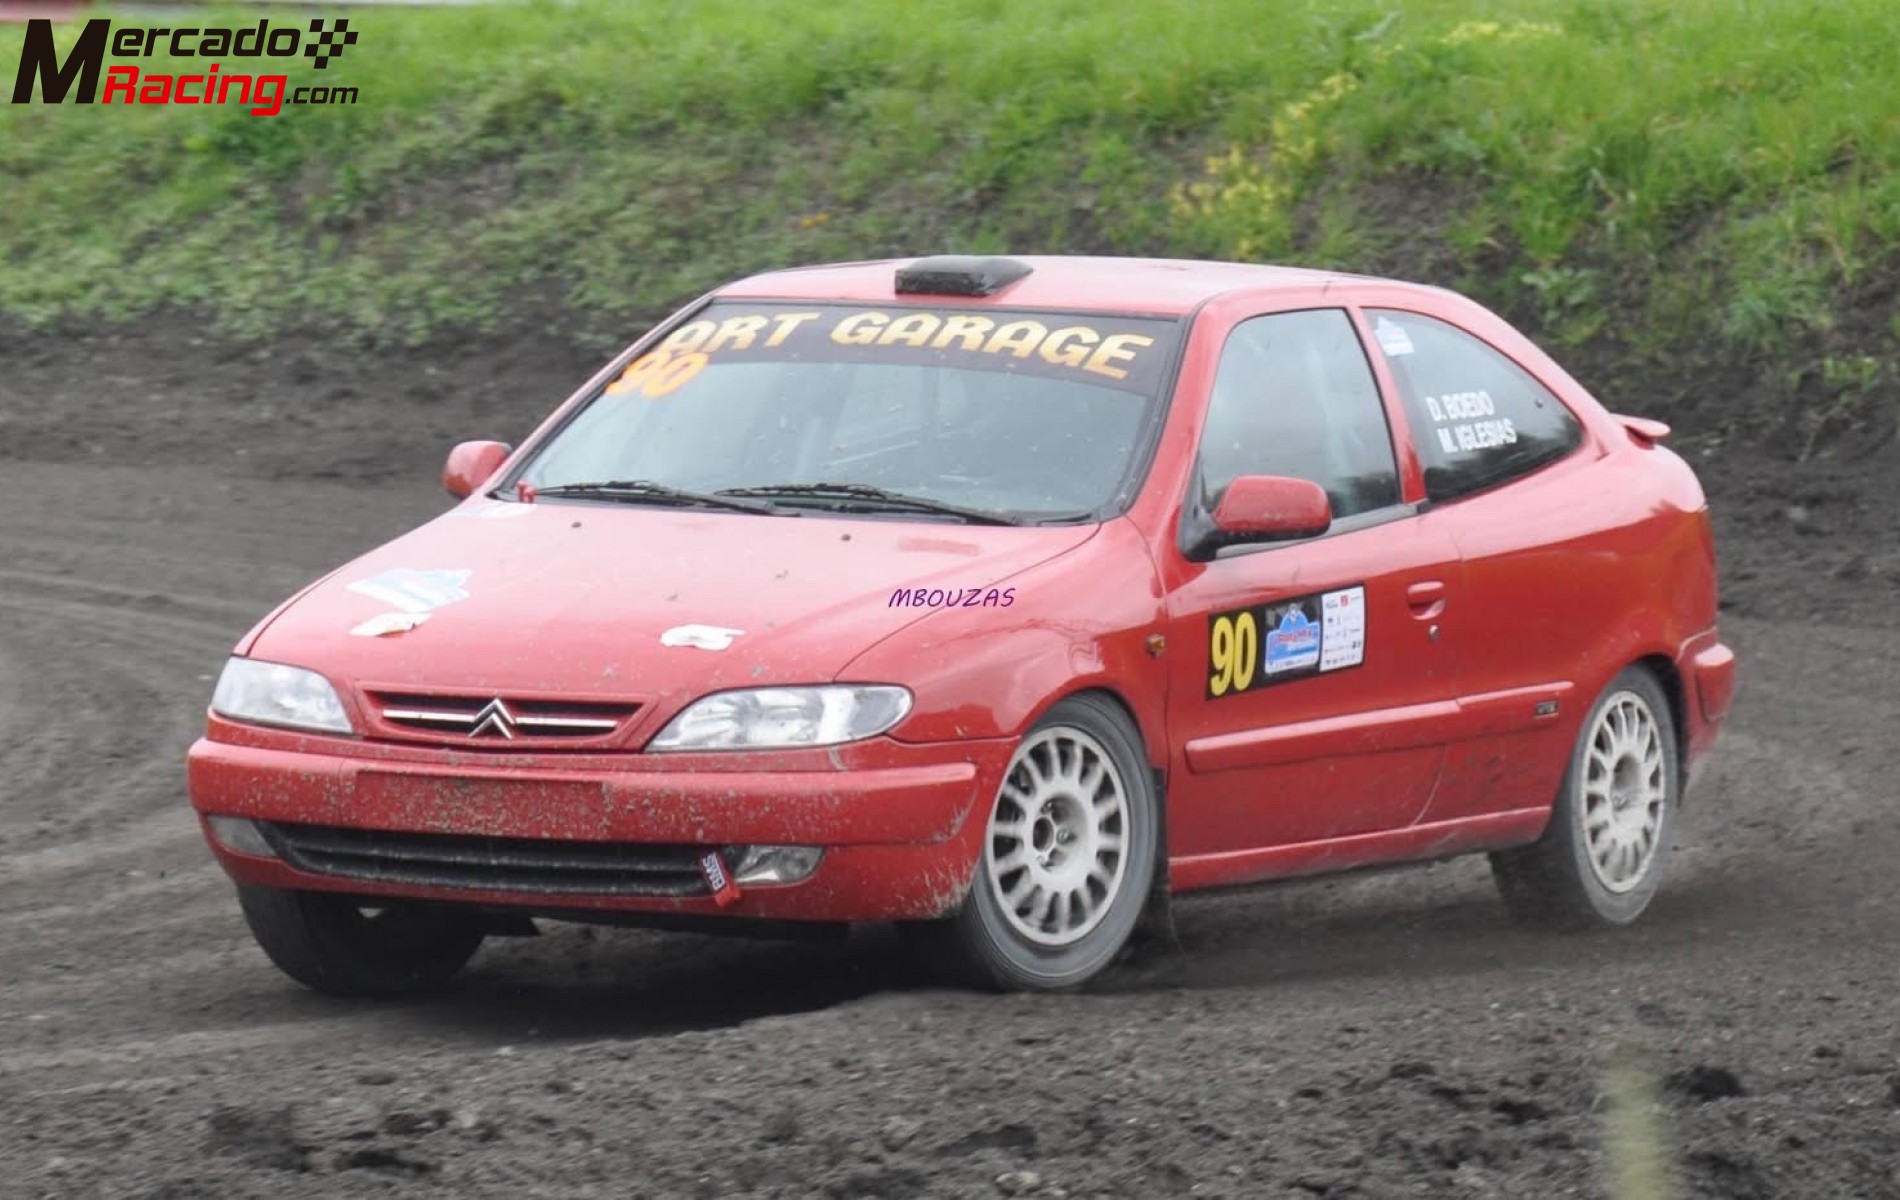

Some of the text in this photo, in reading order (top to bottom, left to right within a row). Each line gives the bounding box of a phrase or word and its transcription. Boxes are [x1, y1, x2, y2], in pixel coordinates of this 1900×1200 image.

[831, 313, 1154, 378] GARAGE
[605, 352, 709, 396] 90
[1425, 396, 1447, 421] D.
[1453, 418, 1517, 451] IGLESIAS
[1211, 612, 1257, 696] 90
